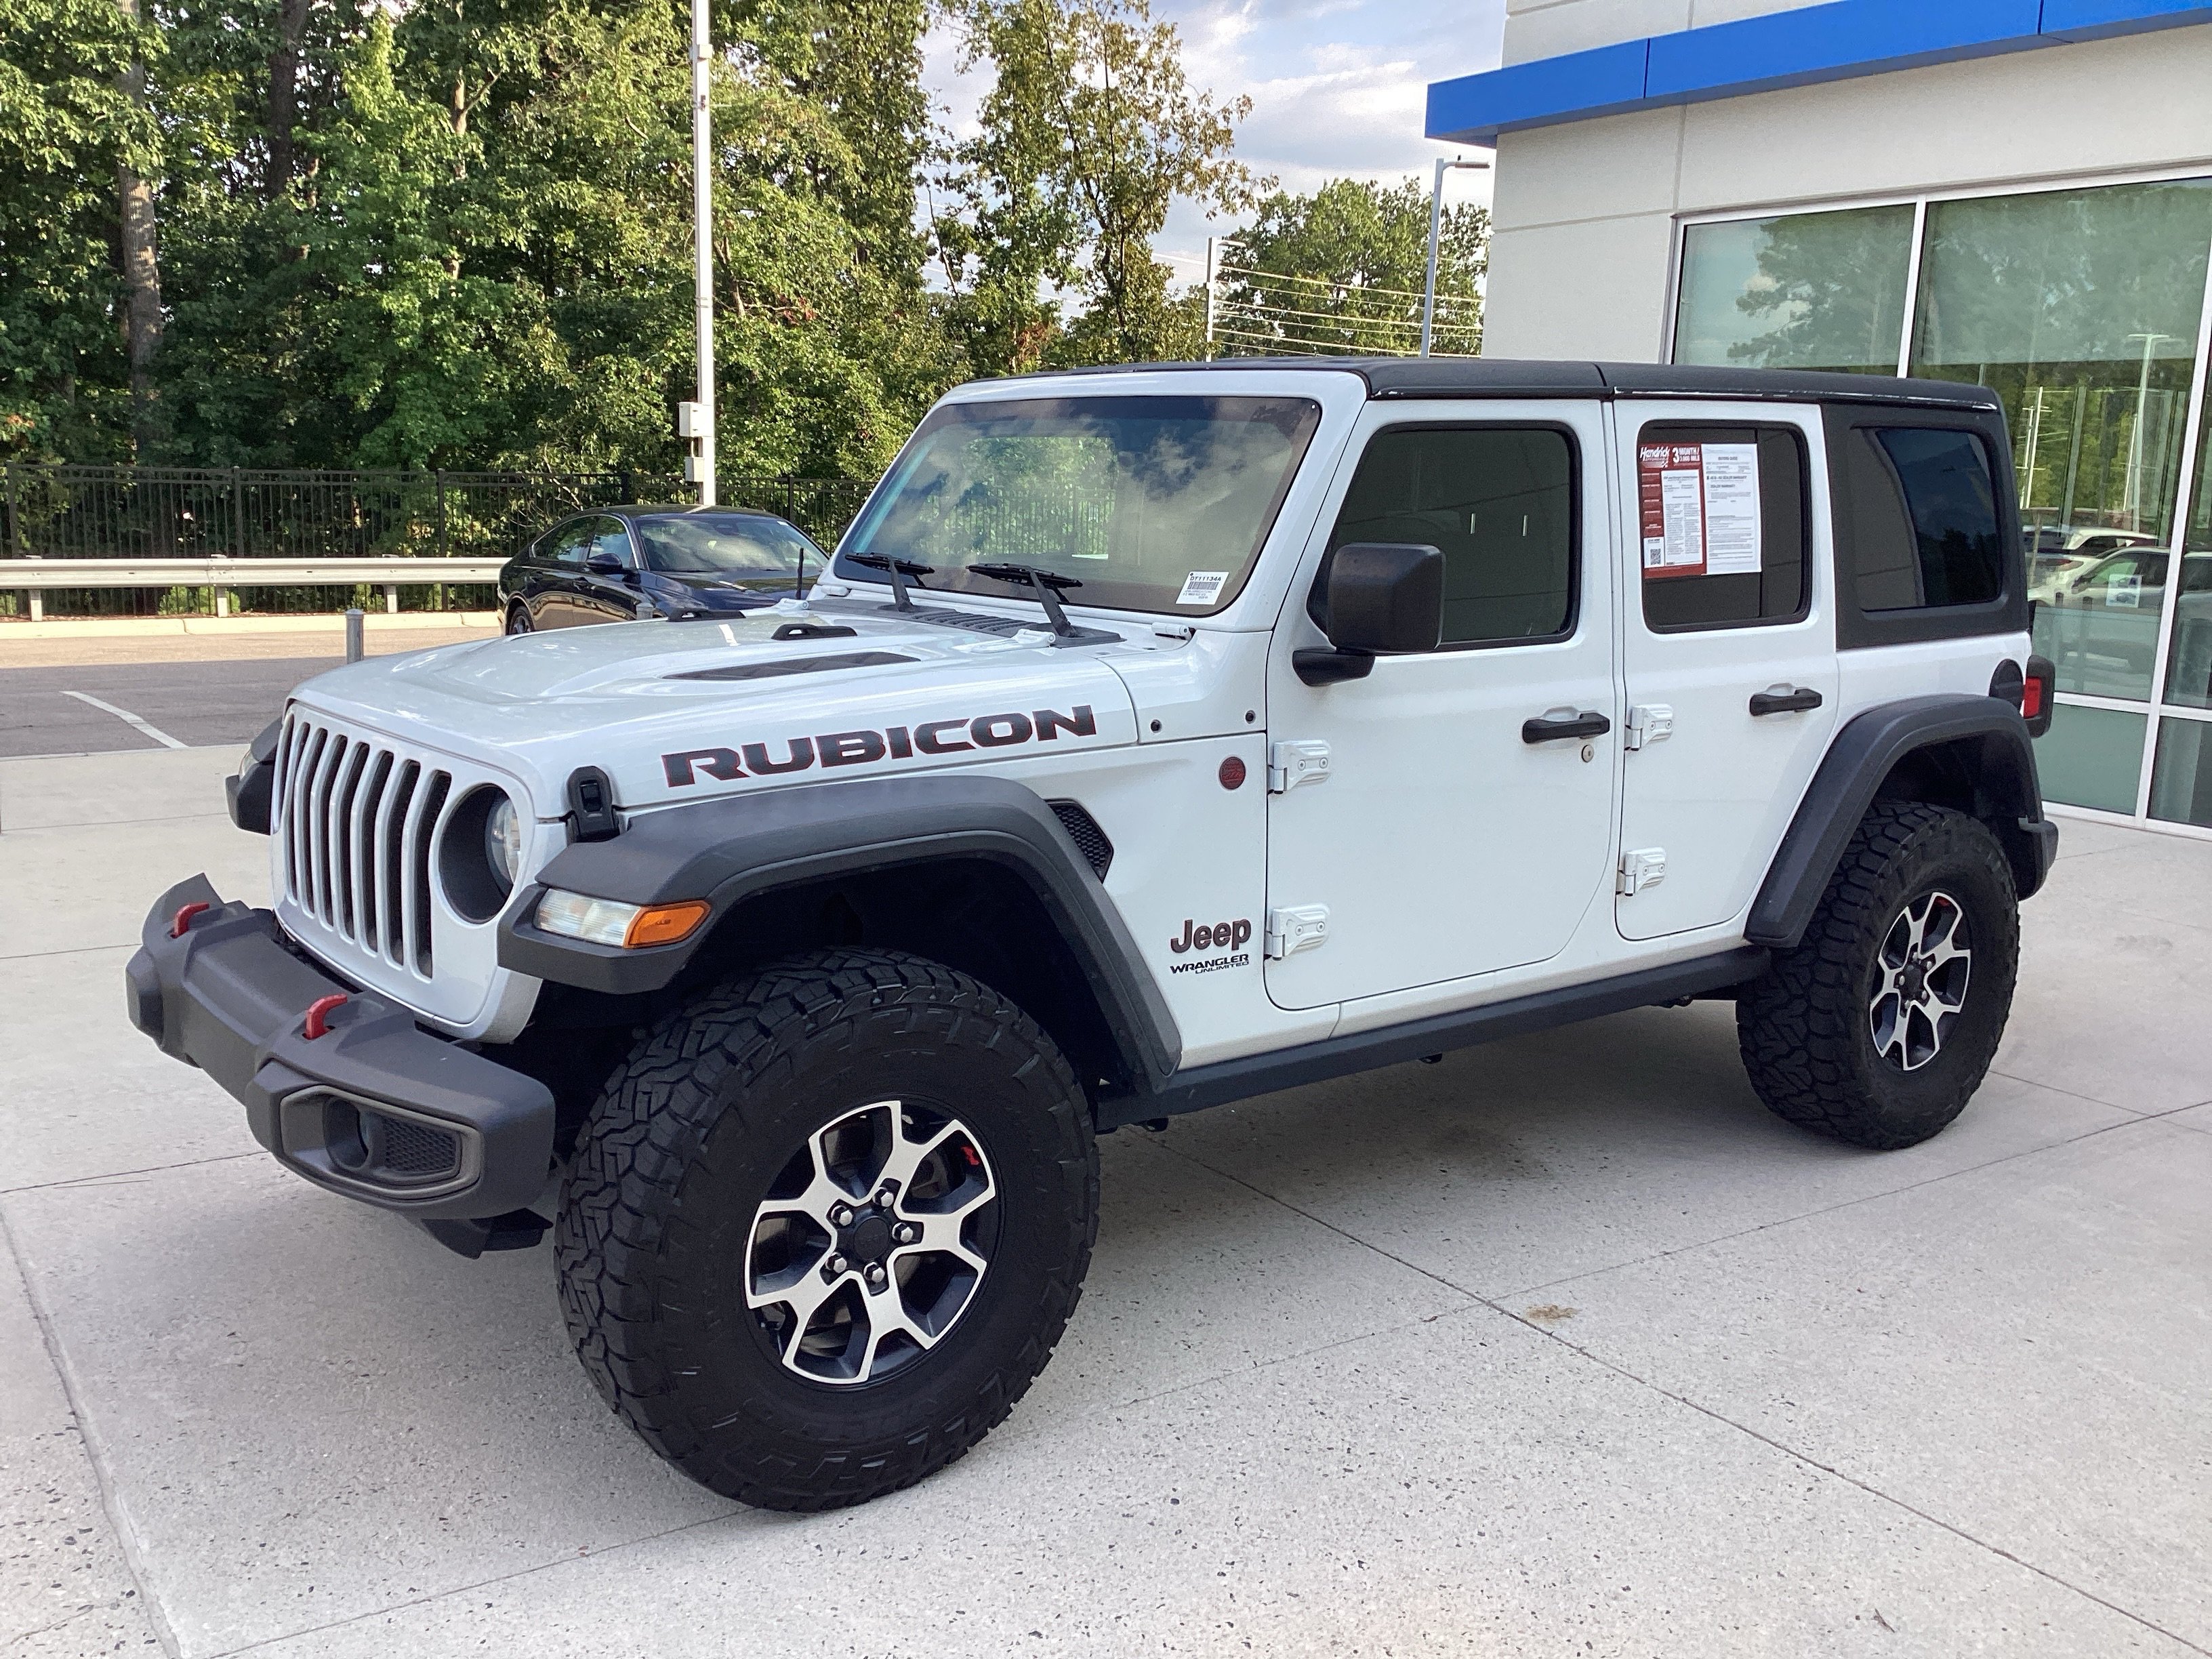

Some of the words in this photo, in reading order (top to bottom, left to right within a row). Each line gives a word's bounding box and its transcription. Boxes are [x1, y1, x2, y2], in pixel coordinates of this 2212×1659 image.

[1673, 447, 1680, 463] 3
[661, 704, 1097, 788] RUBICON
[1170, 918, 1252, 954] Jeep
[1170, 954, 1249, 975] WRANGLER
[1195, 961, 1250, 975] UNLIMITED
